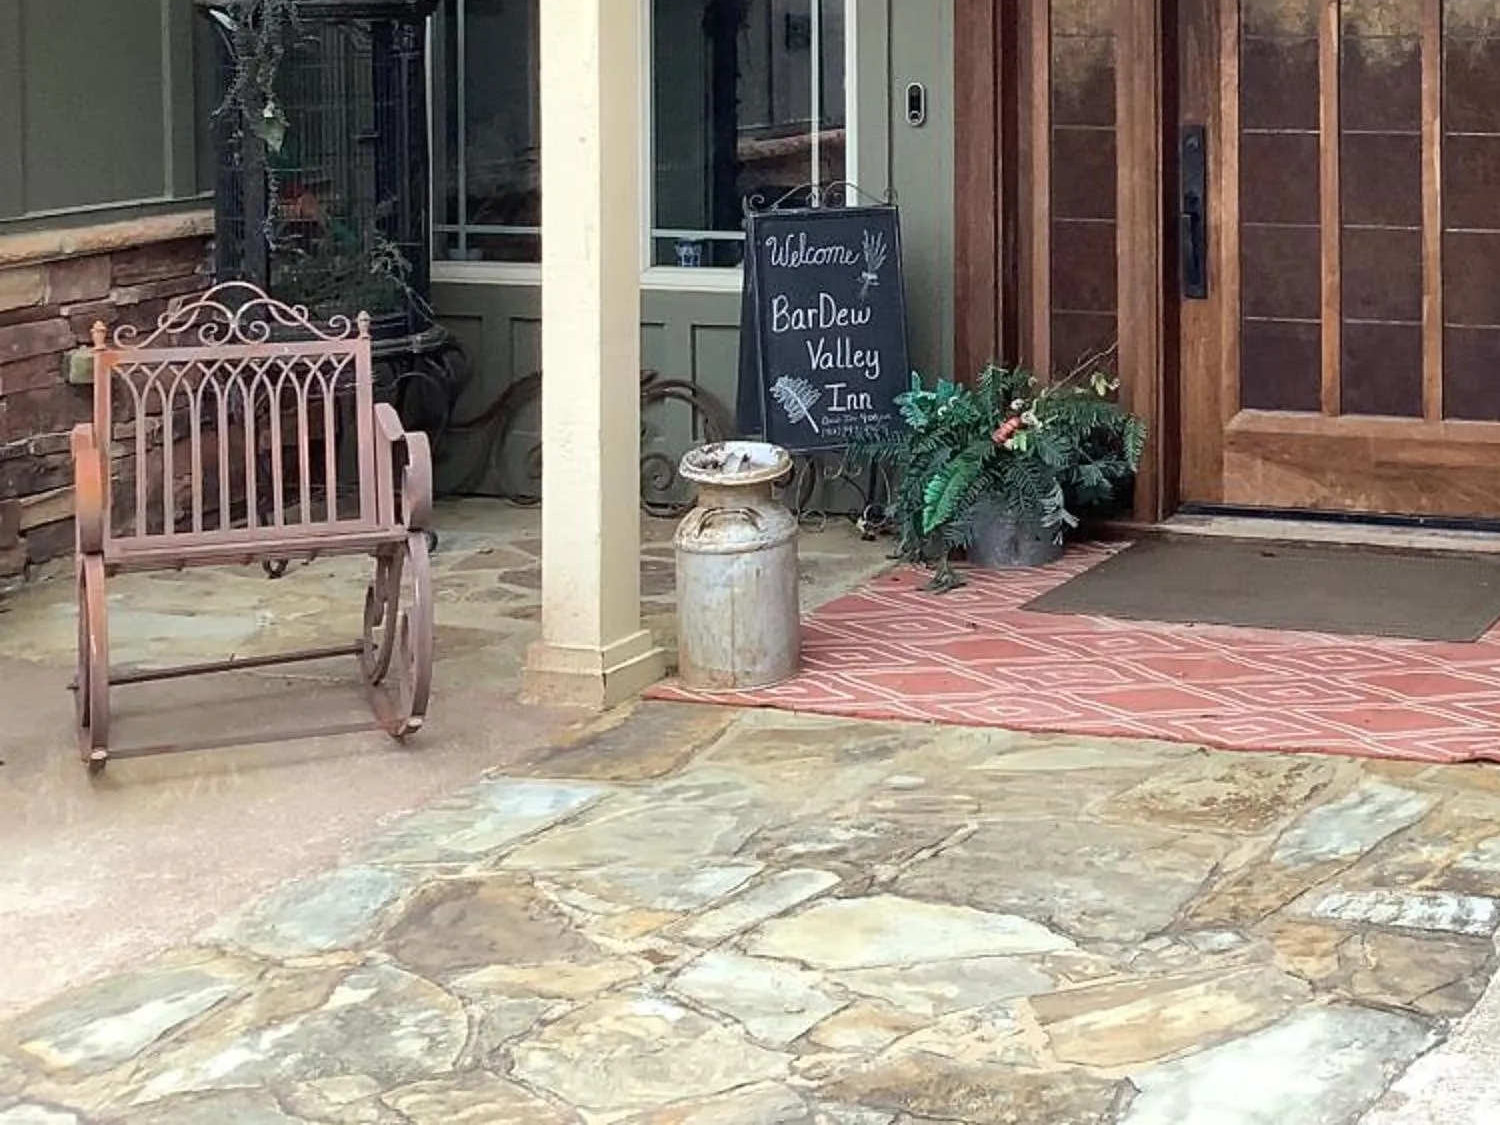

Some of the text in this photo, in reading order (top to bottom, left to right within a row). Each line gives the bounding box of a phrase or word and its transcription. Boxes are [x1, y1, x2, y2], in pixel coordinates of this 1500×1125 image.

[765, 232, 861, 268] Welcome
[771, 292, 871, 333] BarDew
[806, 336, 880, 380] Valley
[824, 382, 873, 412] Inn
